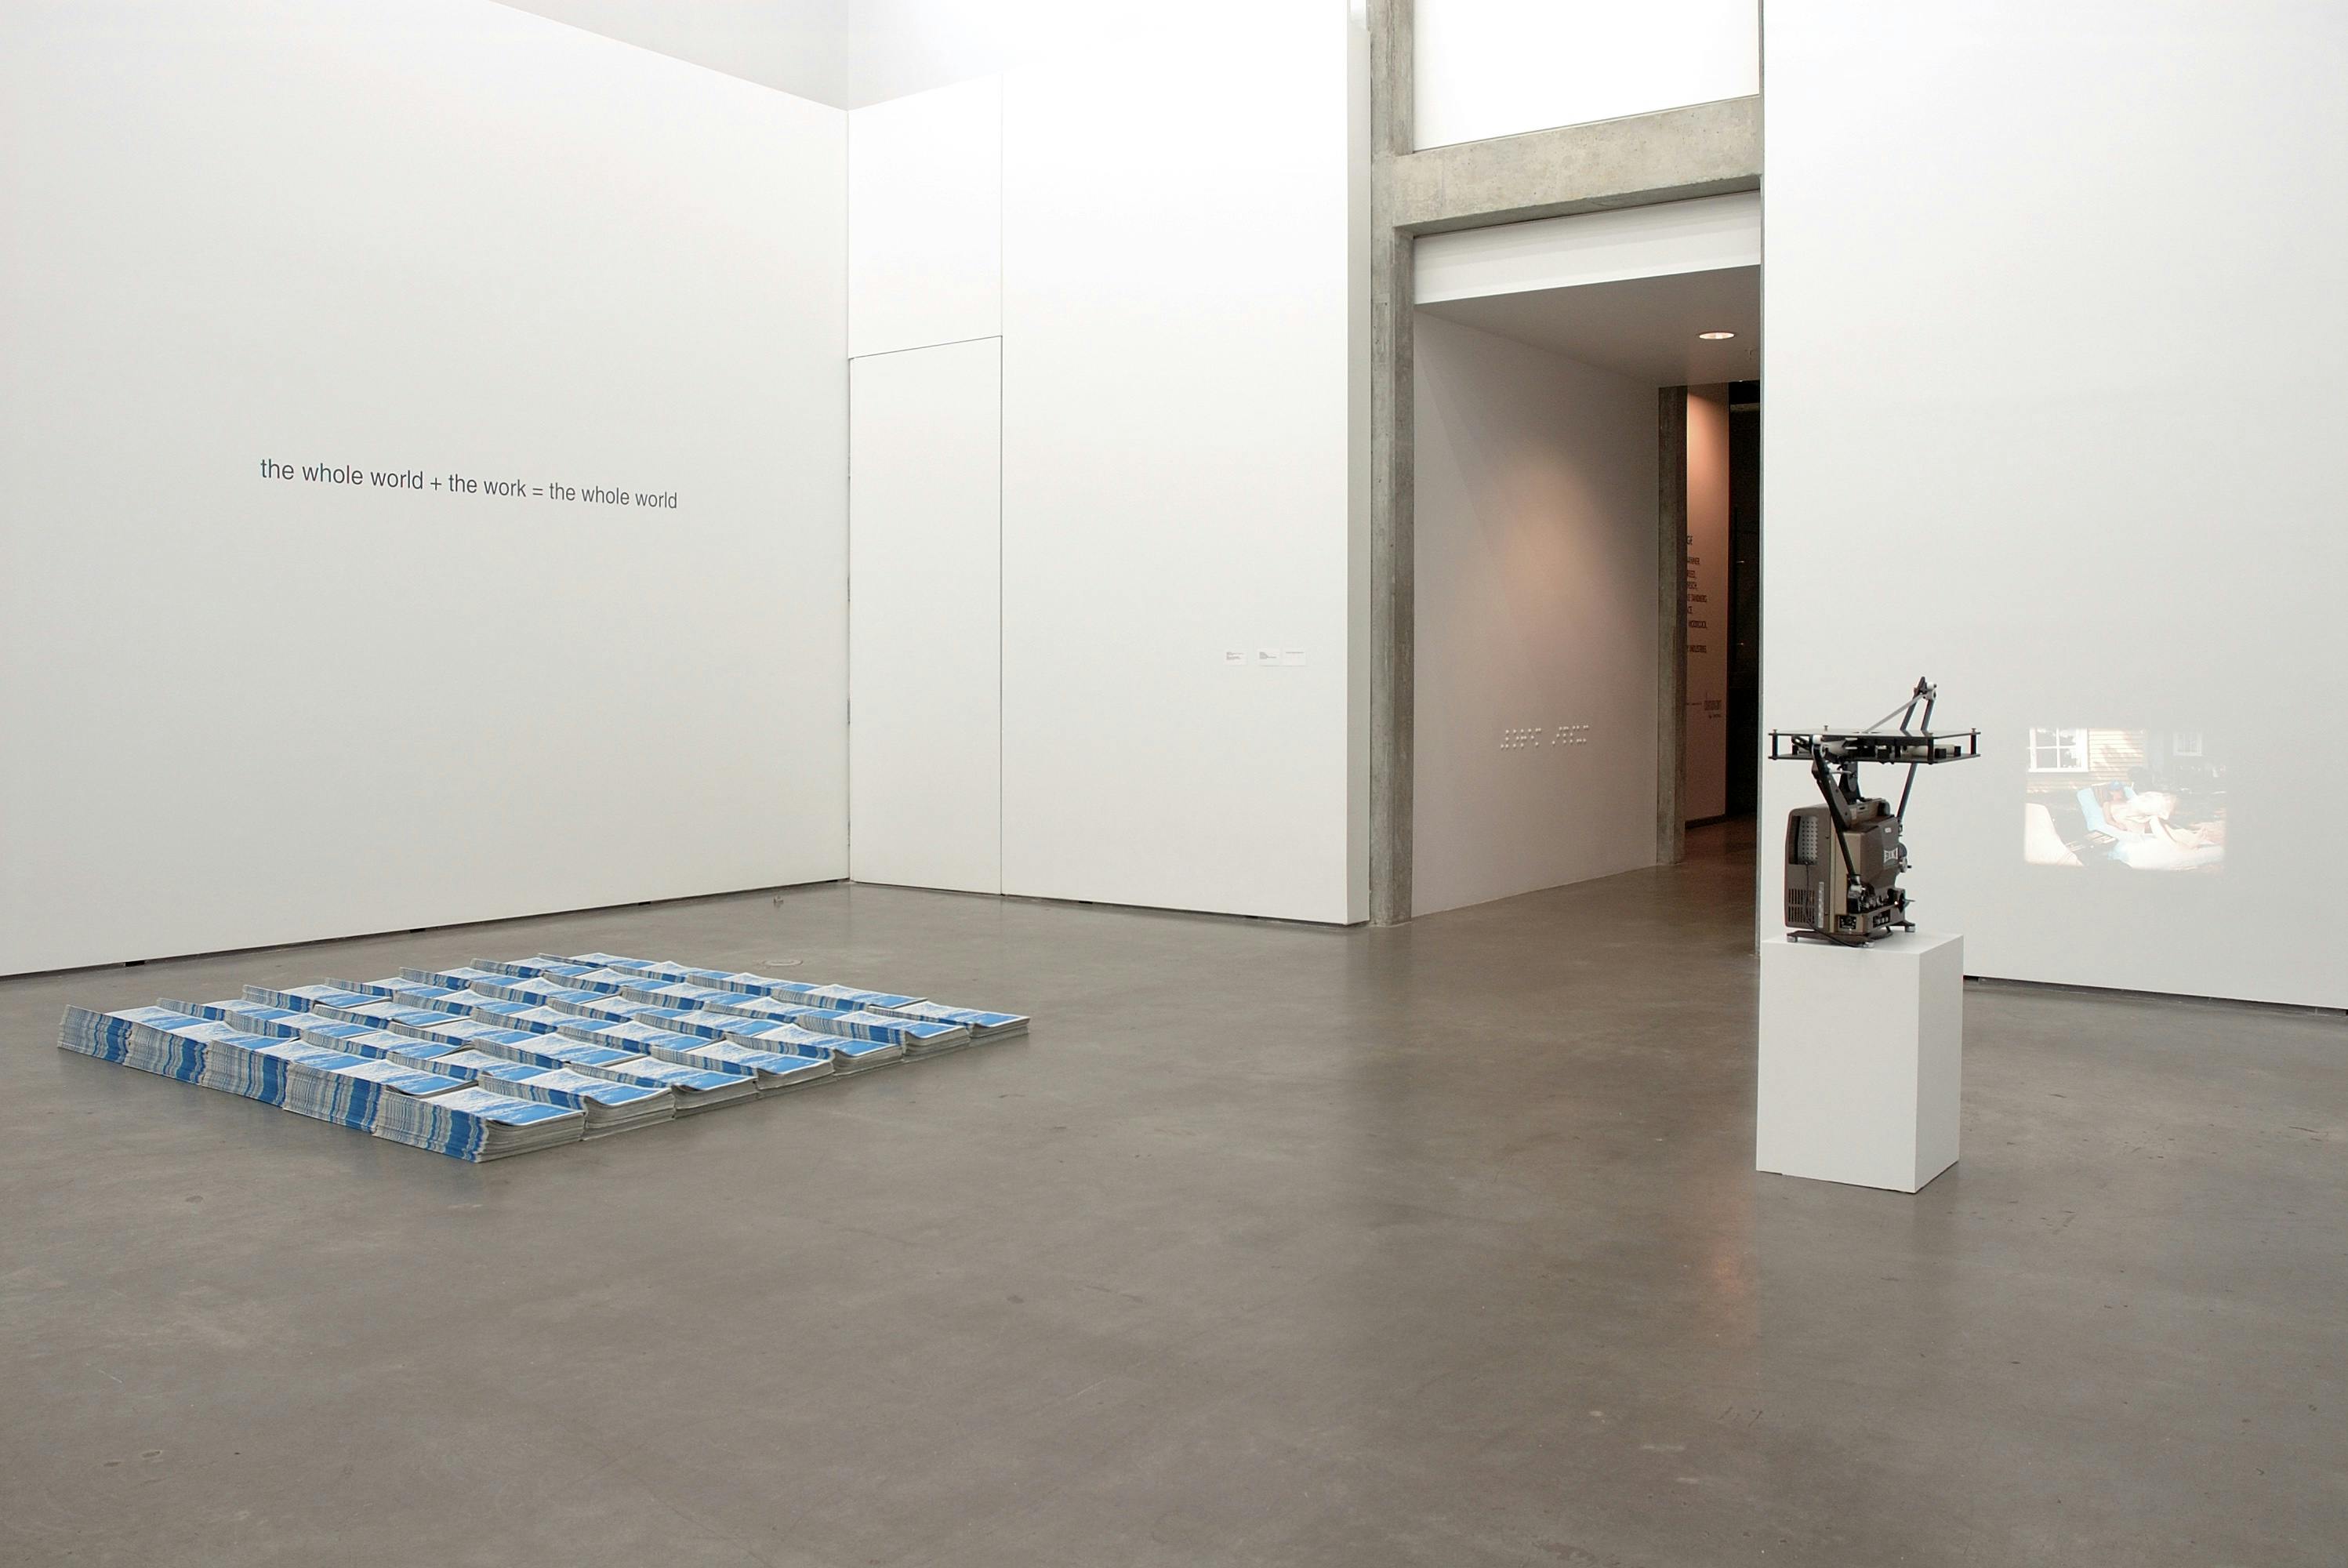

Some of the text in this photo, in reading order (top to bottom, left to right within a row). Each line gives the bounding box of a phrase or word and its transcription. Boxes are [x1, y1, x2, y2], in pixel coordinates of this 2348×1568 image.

[259, 459, 678, 510] the whole world + the work = the whole world
